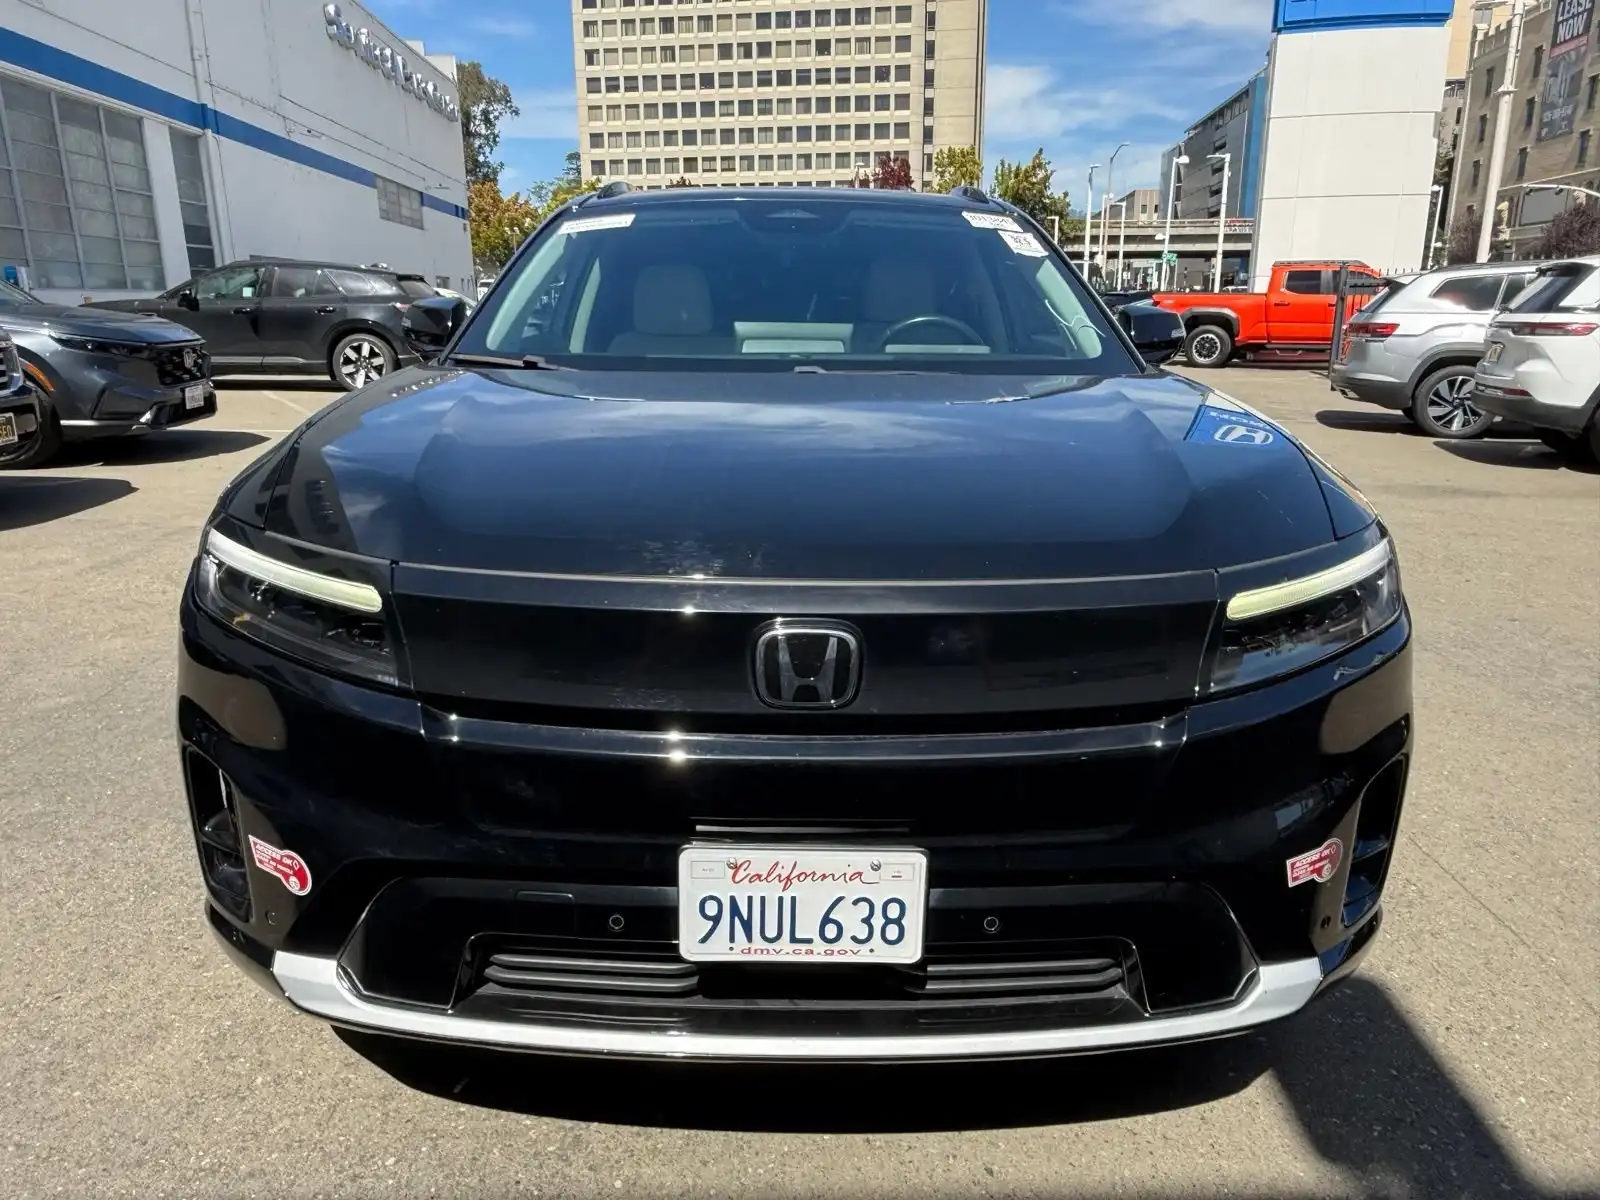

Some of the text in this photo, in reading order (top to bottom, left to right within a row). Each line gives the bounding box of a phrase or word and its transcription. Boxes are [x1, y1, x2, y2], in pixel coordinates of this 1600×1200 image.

[1557, 12, 1588, 44] NOW
[731, 859, 880, 892] California
[697, 894, 906, 946] 9NUL638
[741, 946, 861, 957] dmv.ca.gov
